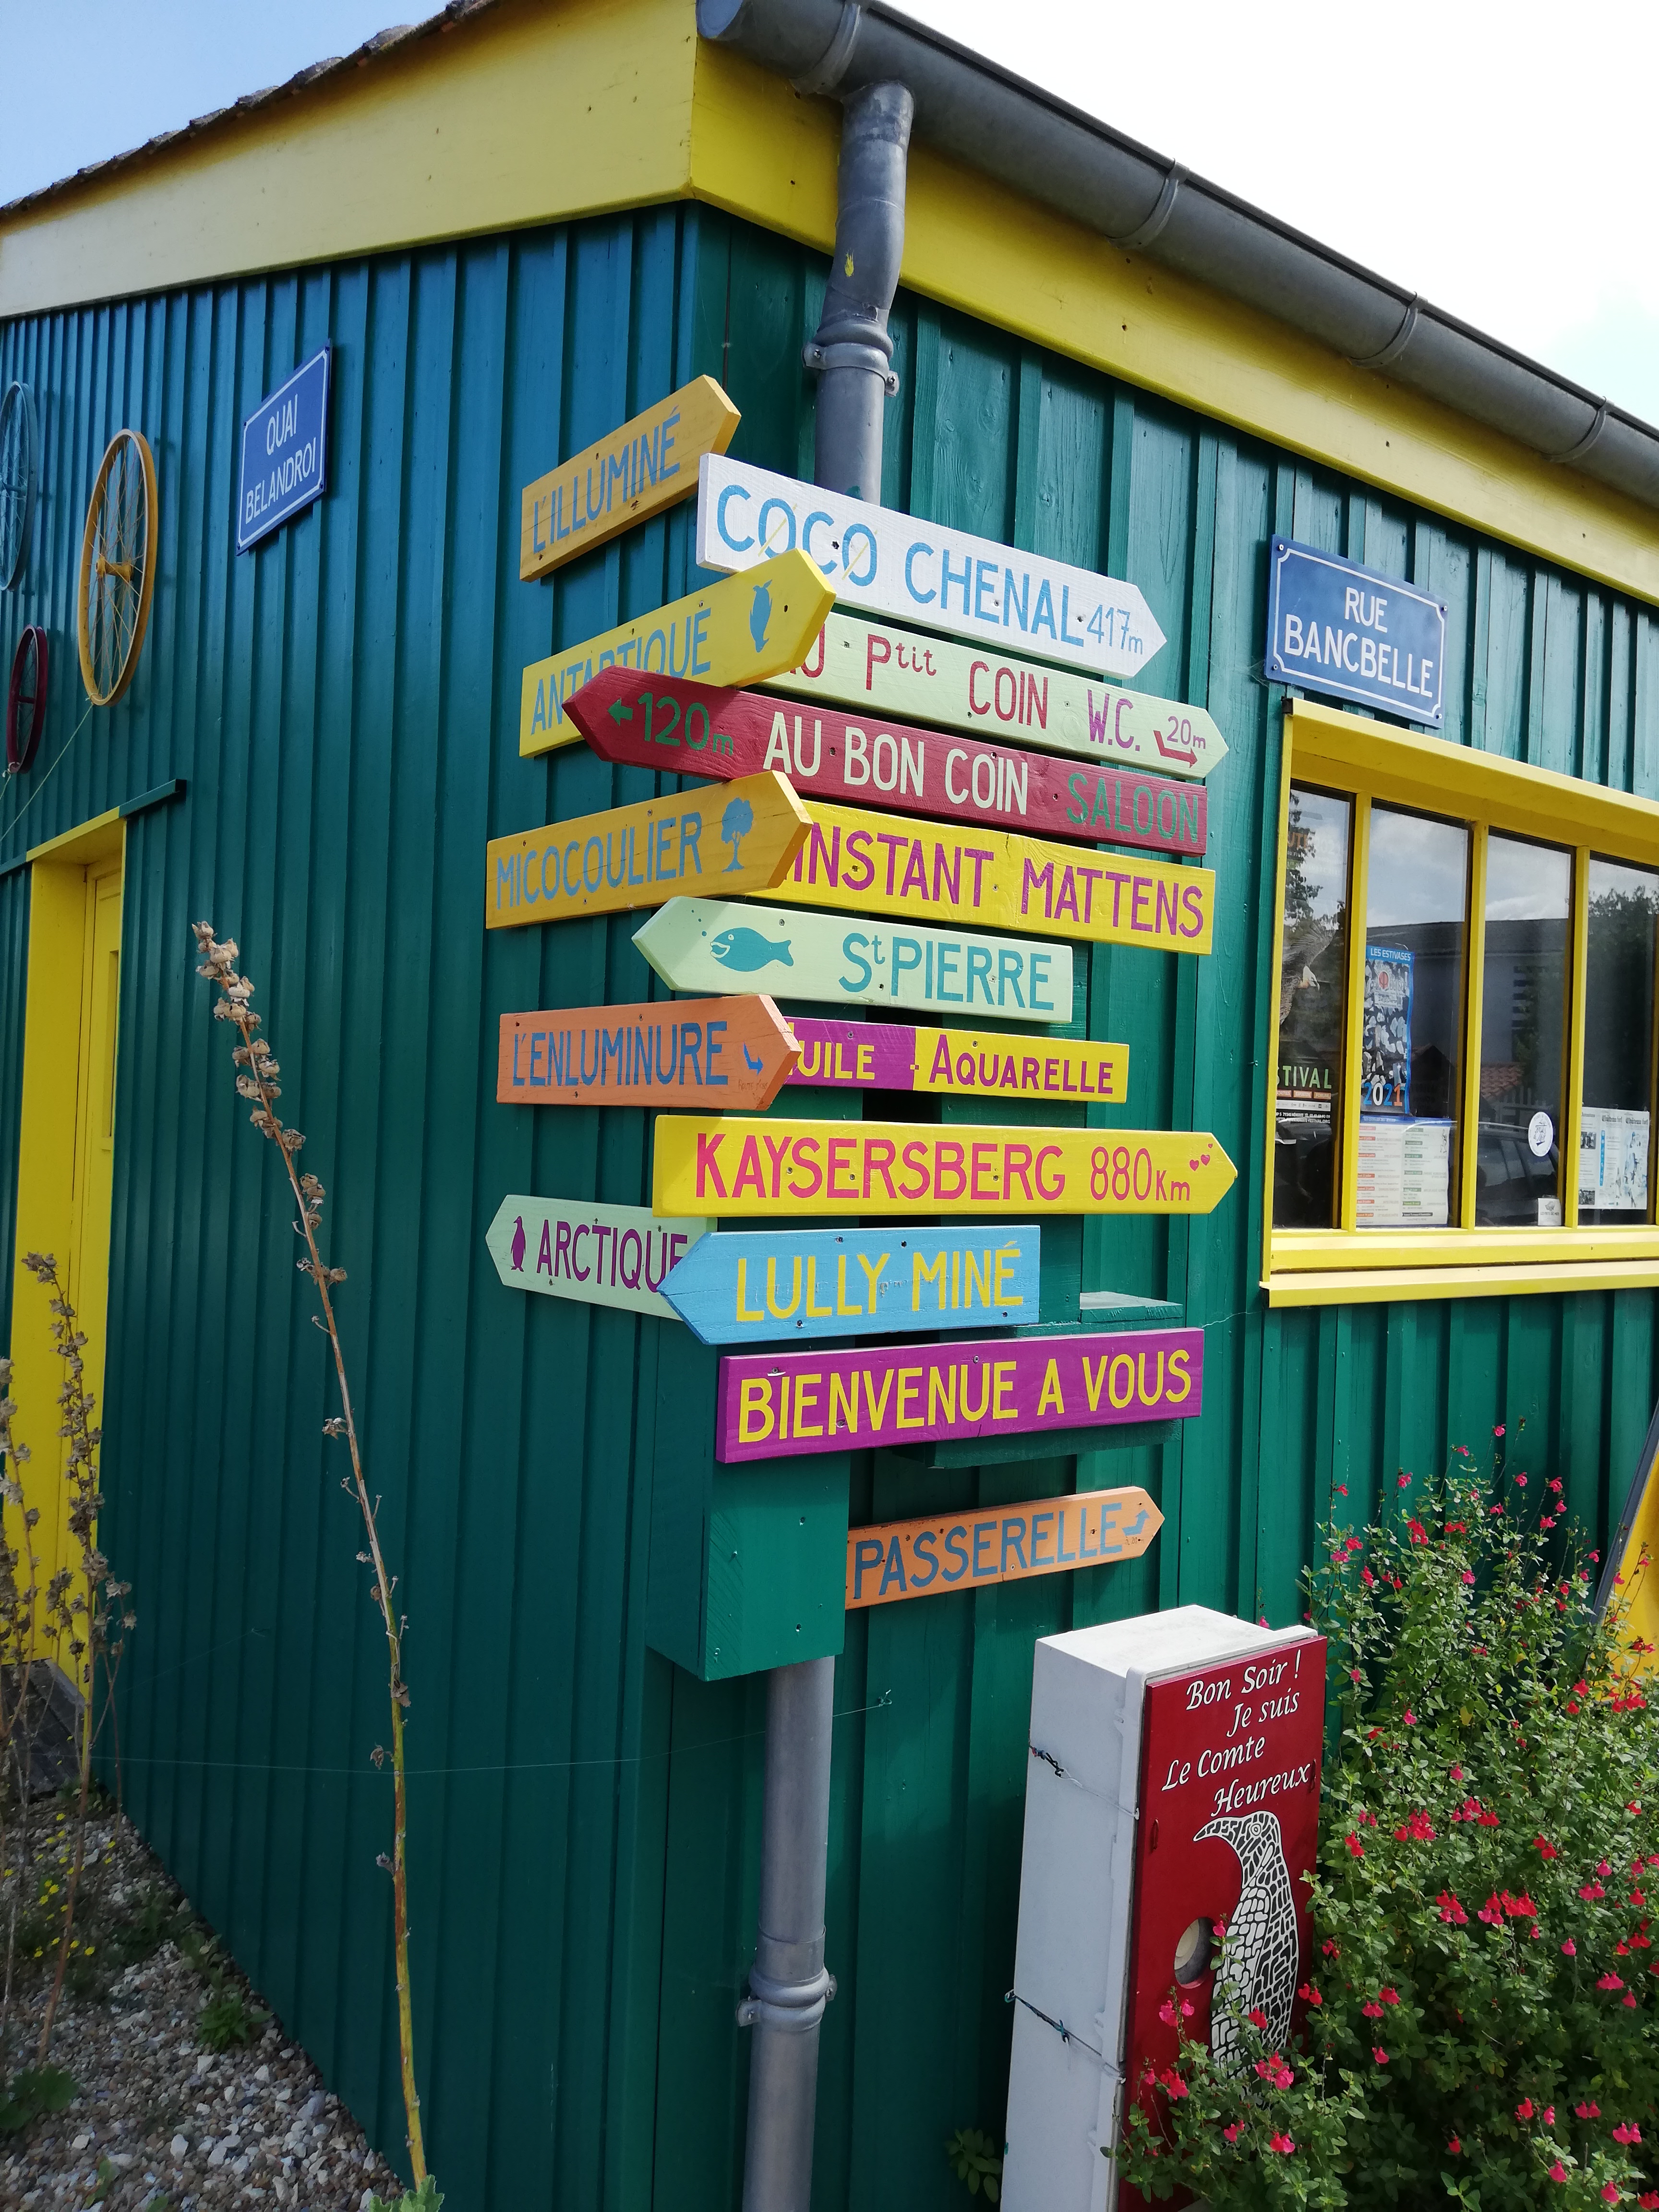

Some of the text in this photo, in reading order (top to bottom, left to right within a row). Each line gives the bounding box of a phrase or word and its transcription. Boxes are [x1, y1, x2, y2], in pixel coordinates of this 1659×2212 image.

[266, 394, 298, 455] QUAI
[245, 437, 316, 524] BELANDROI
[905, 542, 1084, 647] CHENAL
[1345, 587, 1387, 633] RUE
[790, 623, 825, 678] U
[969, 660, 1048, 730] COIN
[1087, 689, 1141, 752] W.C.
[1285, 613, 1433, 698] BANCBELLE
[763, 711, 822, 777] AU
[844, 726, 925, 797] BON
[945, 749, 1028, 816] COIN
[1067, 773, 1198, 844] SALOON
[496, 811, 703, 910] MICOCOULIER
[1021, 858, 1204, 938] MATTENS
[1370, 948, 1381, 957] LES
[512, 1021, 729, 1087] L'ENLUMINURE
[788, 1022, 875, 1080] UILE
[1277, 1065, 1332, 1089] TIVAL
[1364, 1082, 1403, 1106] 2021
[695, 1132, 1065, 1202] KAYSERSBERG
[736, 1240, 1023, 1322] LULLY MINÉ
[739, 1349, 1191, 1443] BIENVENUE A VOUS
[853, 1502, 1123, 1599] PASSERELLE
[1186, 1679, 1232, 1711] Bon
[1241, 1659, 1288, 1694] Soir
[1226, 1688, 1300, 1738] Je suis
[1161, 1735, 1265, 1791] Le Comte
[1211, 1763, 1311, 1817] Heureux
